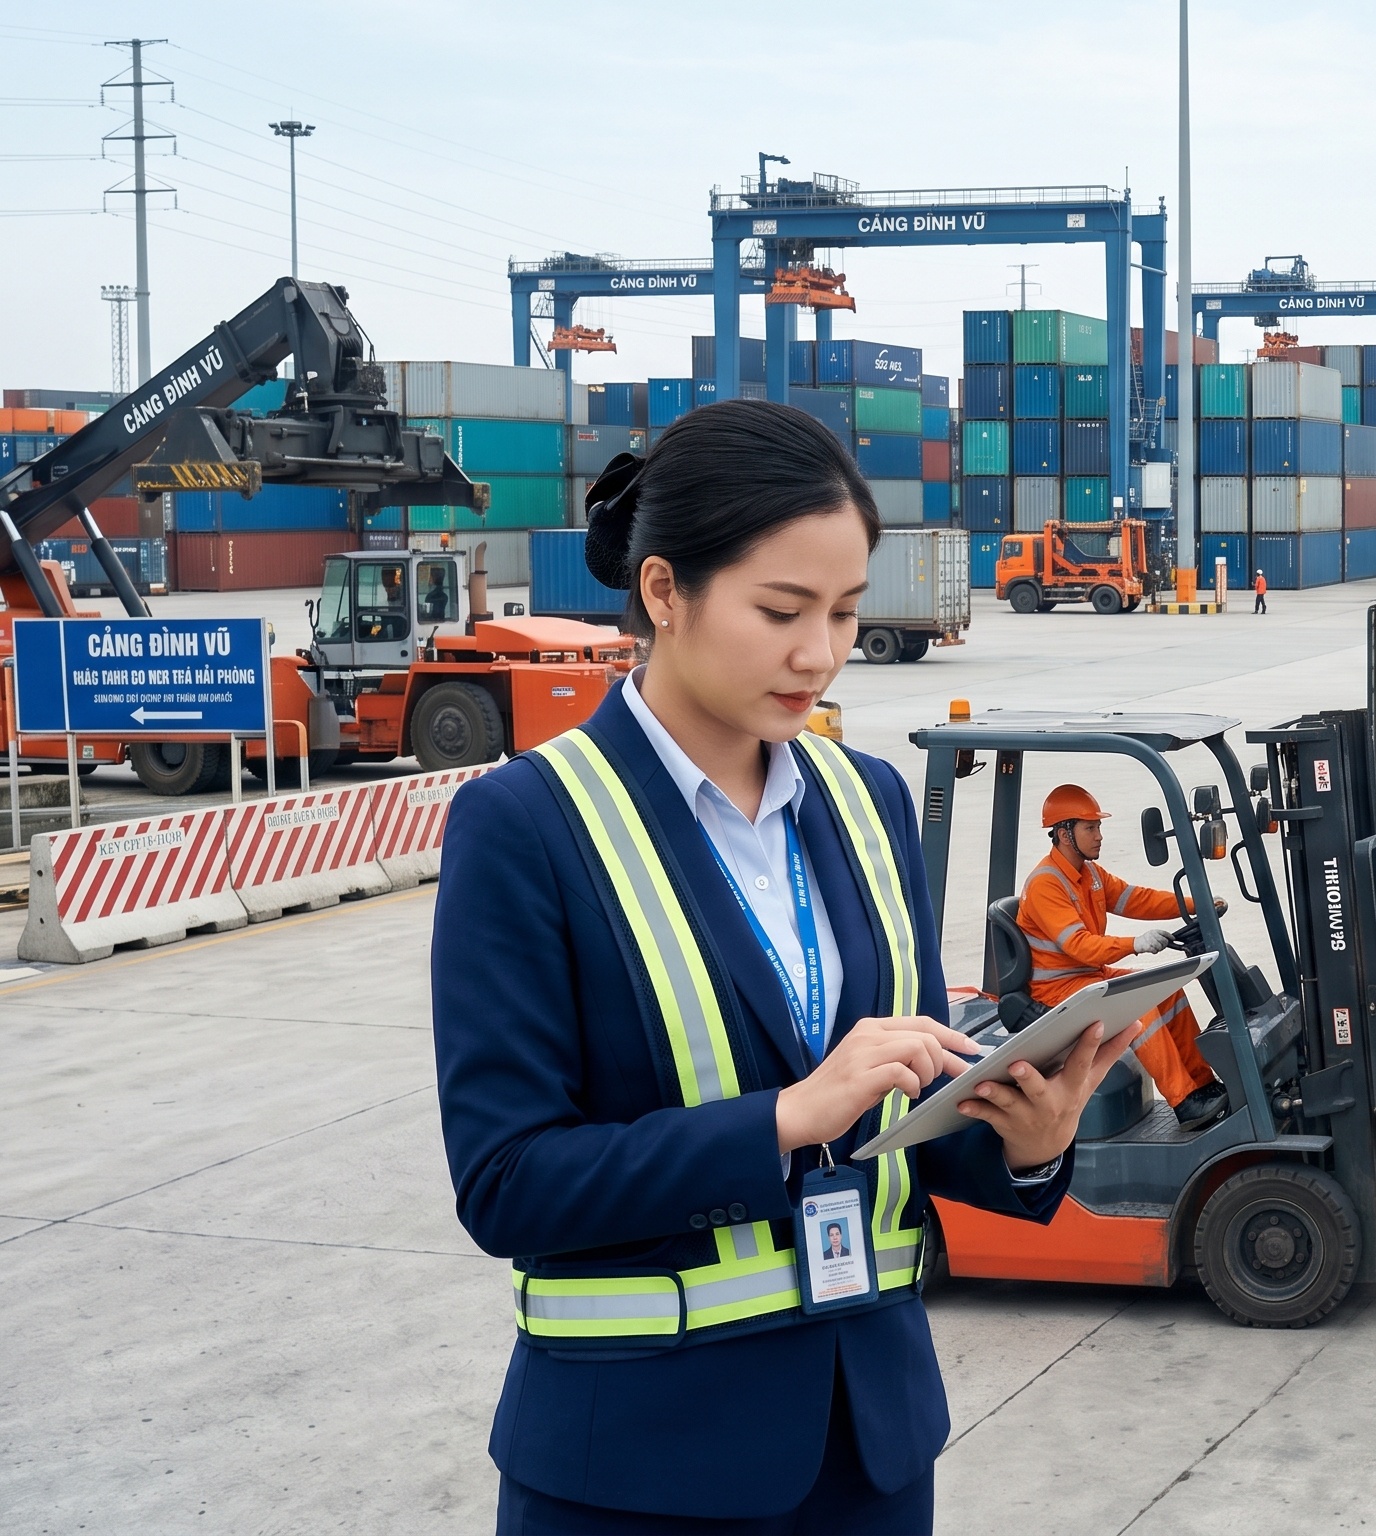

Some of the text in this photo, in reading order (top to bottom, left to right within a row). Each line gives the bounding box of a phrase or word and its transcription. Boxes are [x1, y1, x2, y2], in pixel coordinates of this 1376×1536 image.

[199, 345, 224, 376] VŨ
[88, 626, 231, 657] CẢNG ĐÌNH VŨ
[195, 664, 214, 685] HẢI
[217, 667, 255, 685] PHÒNG
